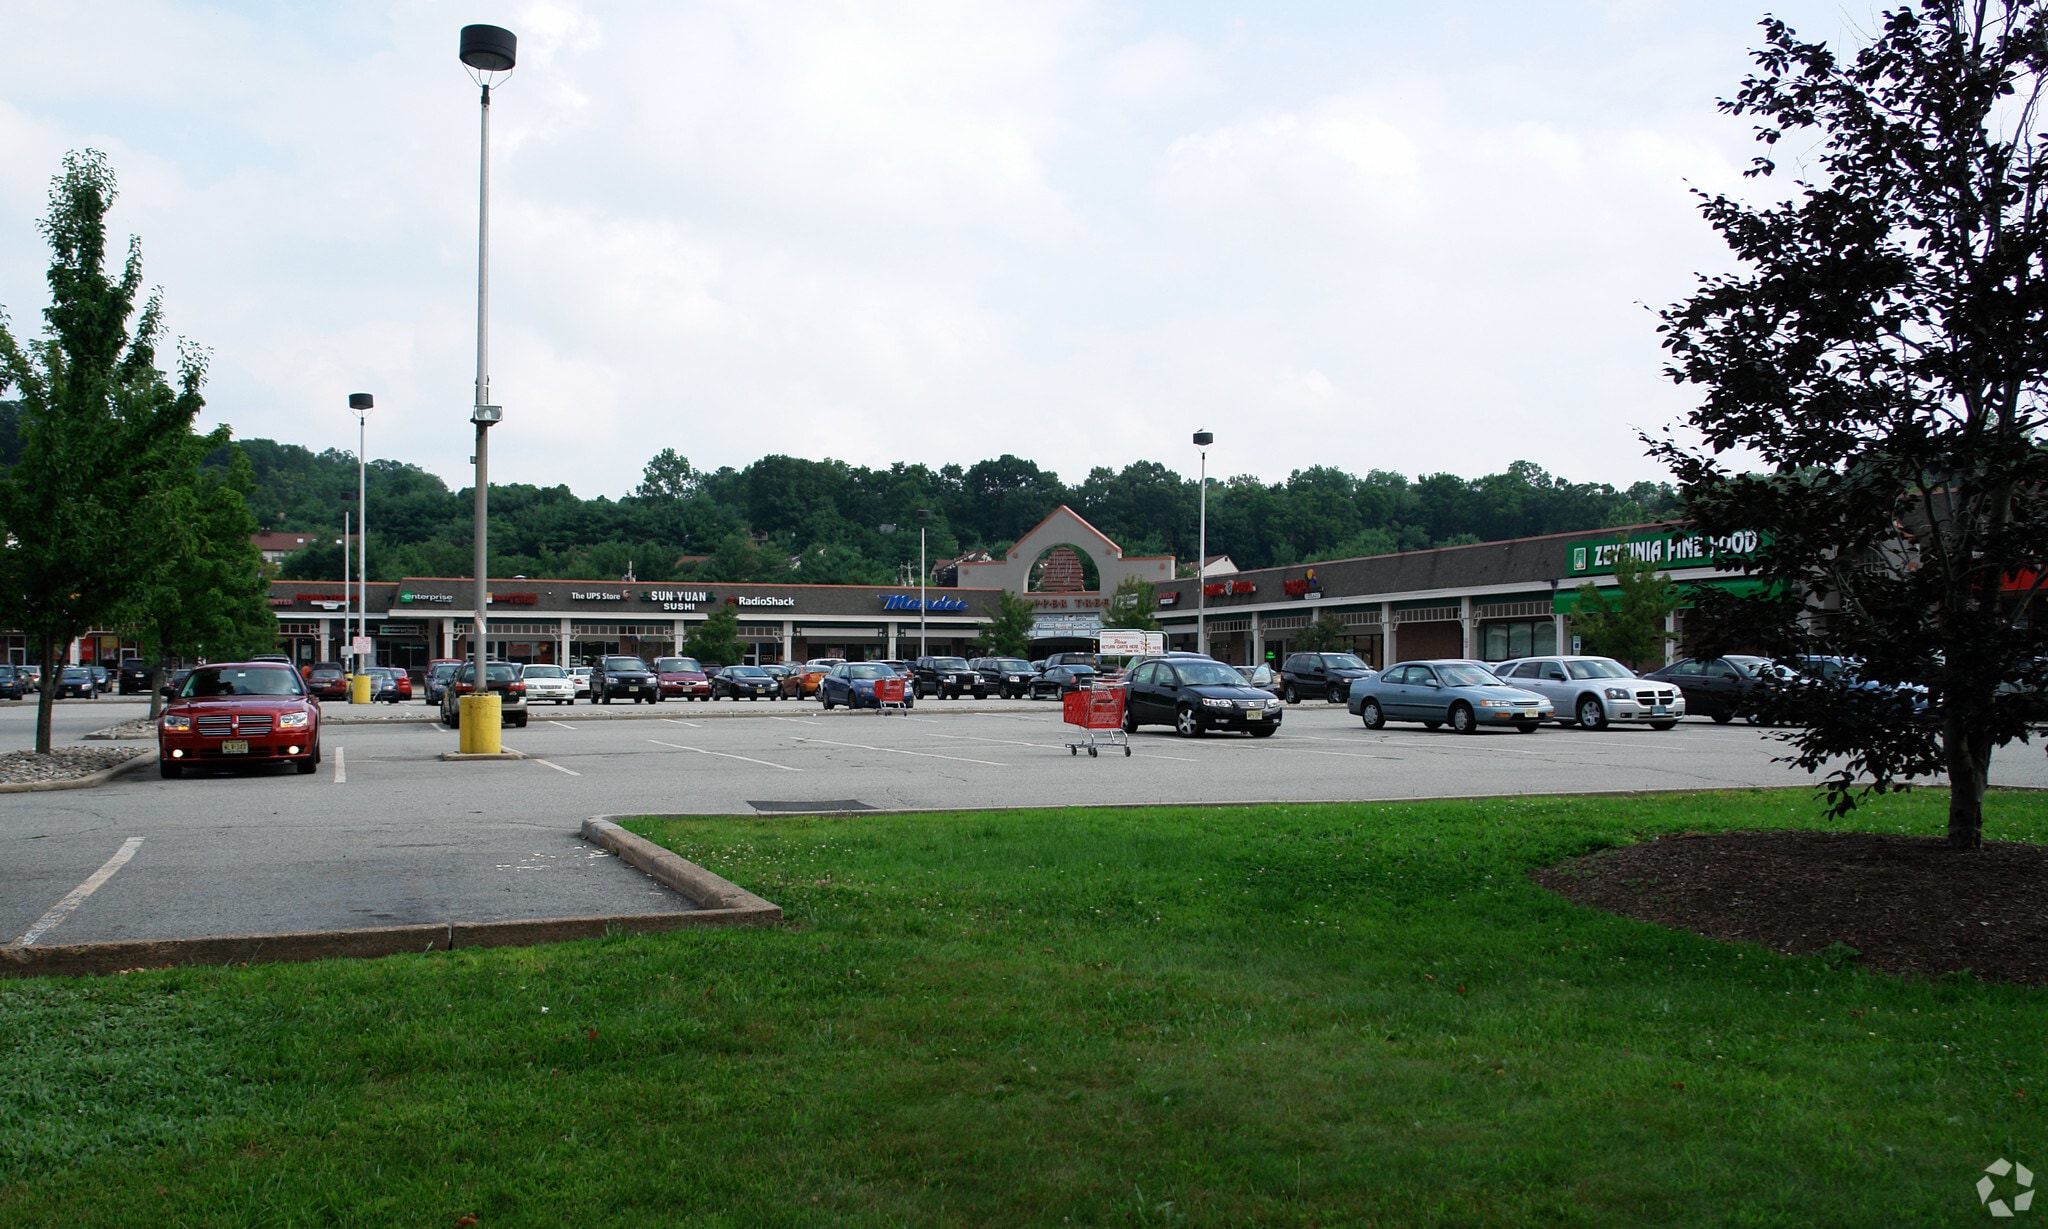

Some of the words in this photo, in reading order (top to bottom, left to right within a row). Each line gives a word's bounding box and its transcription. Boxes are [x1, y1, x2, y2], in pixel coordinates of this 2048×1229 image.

[401, 593, 453, 602] enterprise
[571, 592, 585, 600] The
[586, 592, 601, 600] UPS
[602, 592, 621, 600] Store
[651, 591, 673, 601] SUN
[677, 591, 706, 602] YUAN
[738, 596, 795, 606] RadioShack
[877, 594, 969, 611] Mandee
[663, 602, 695, 610] SUSHI
